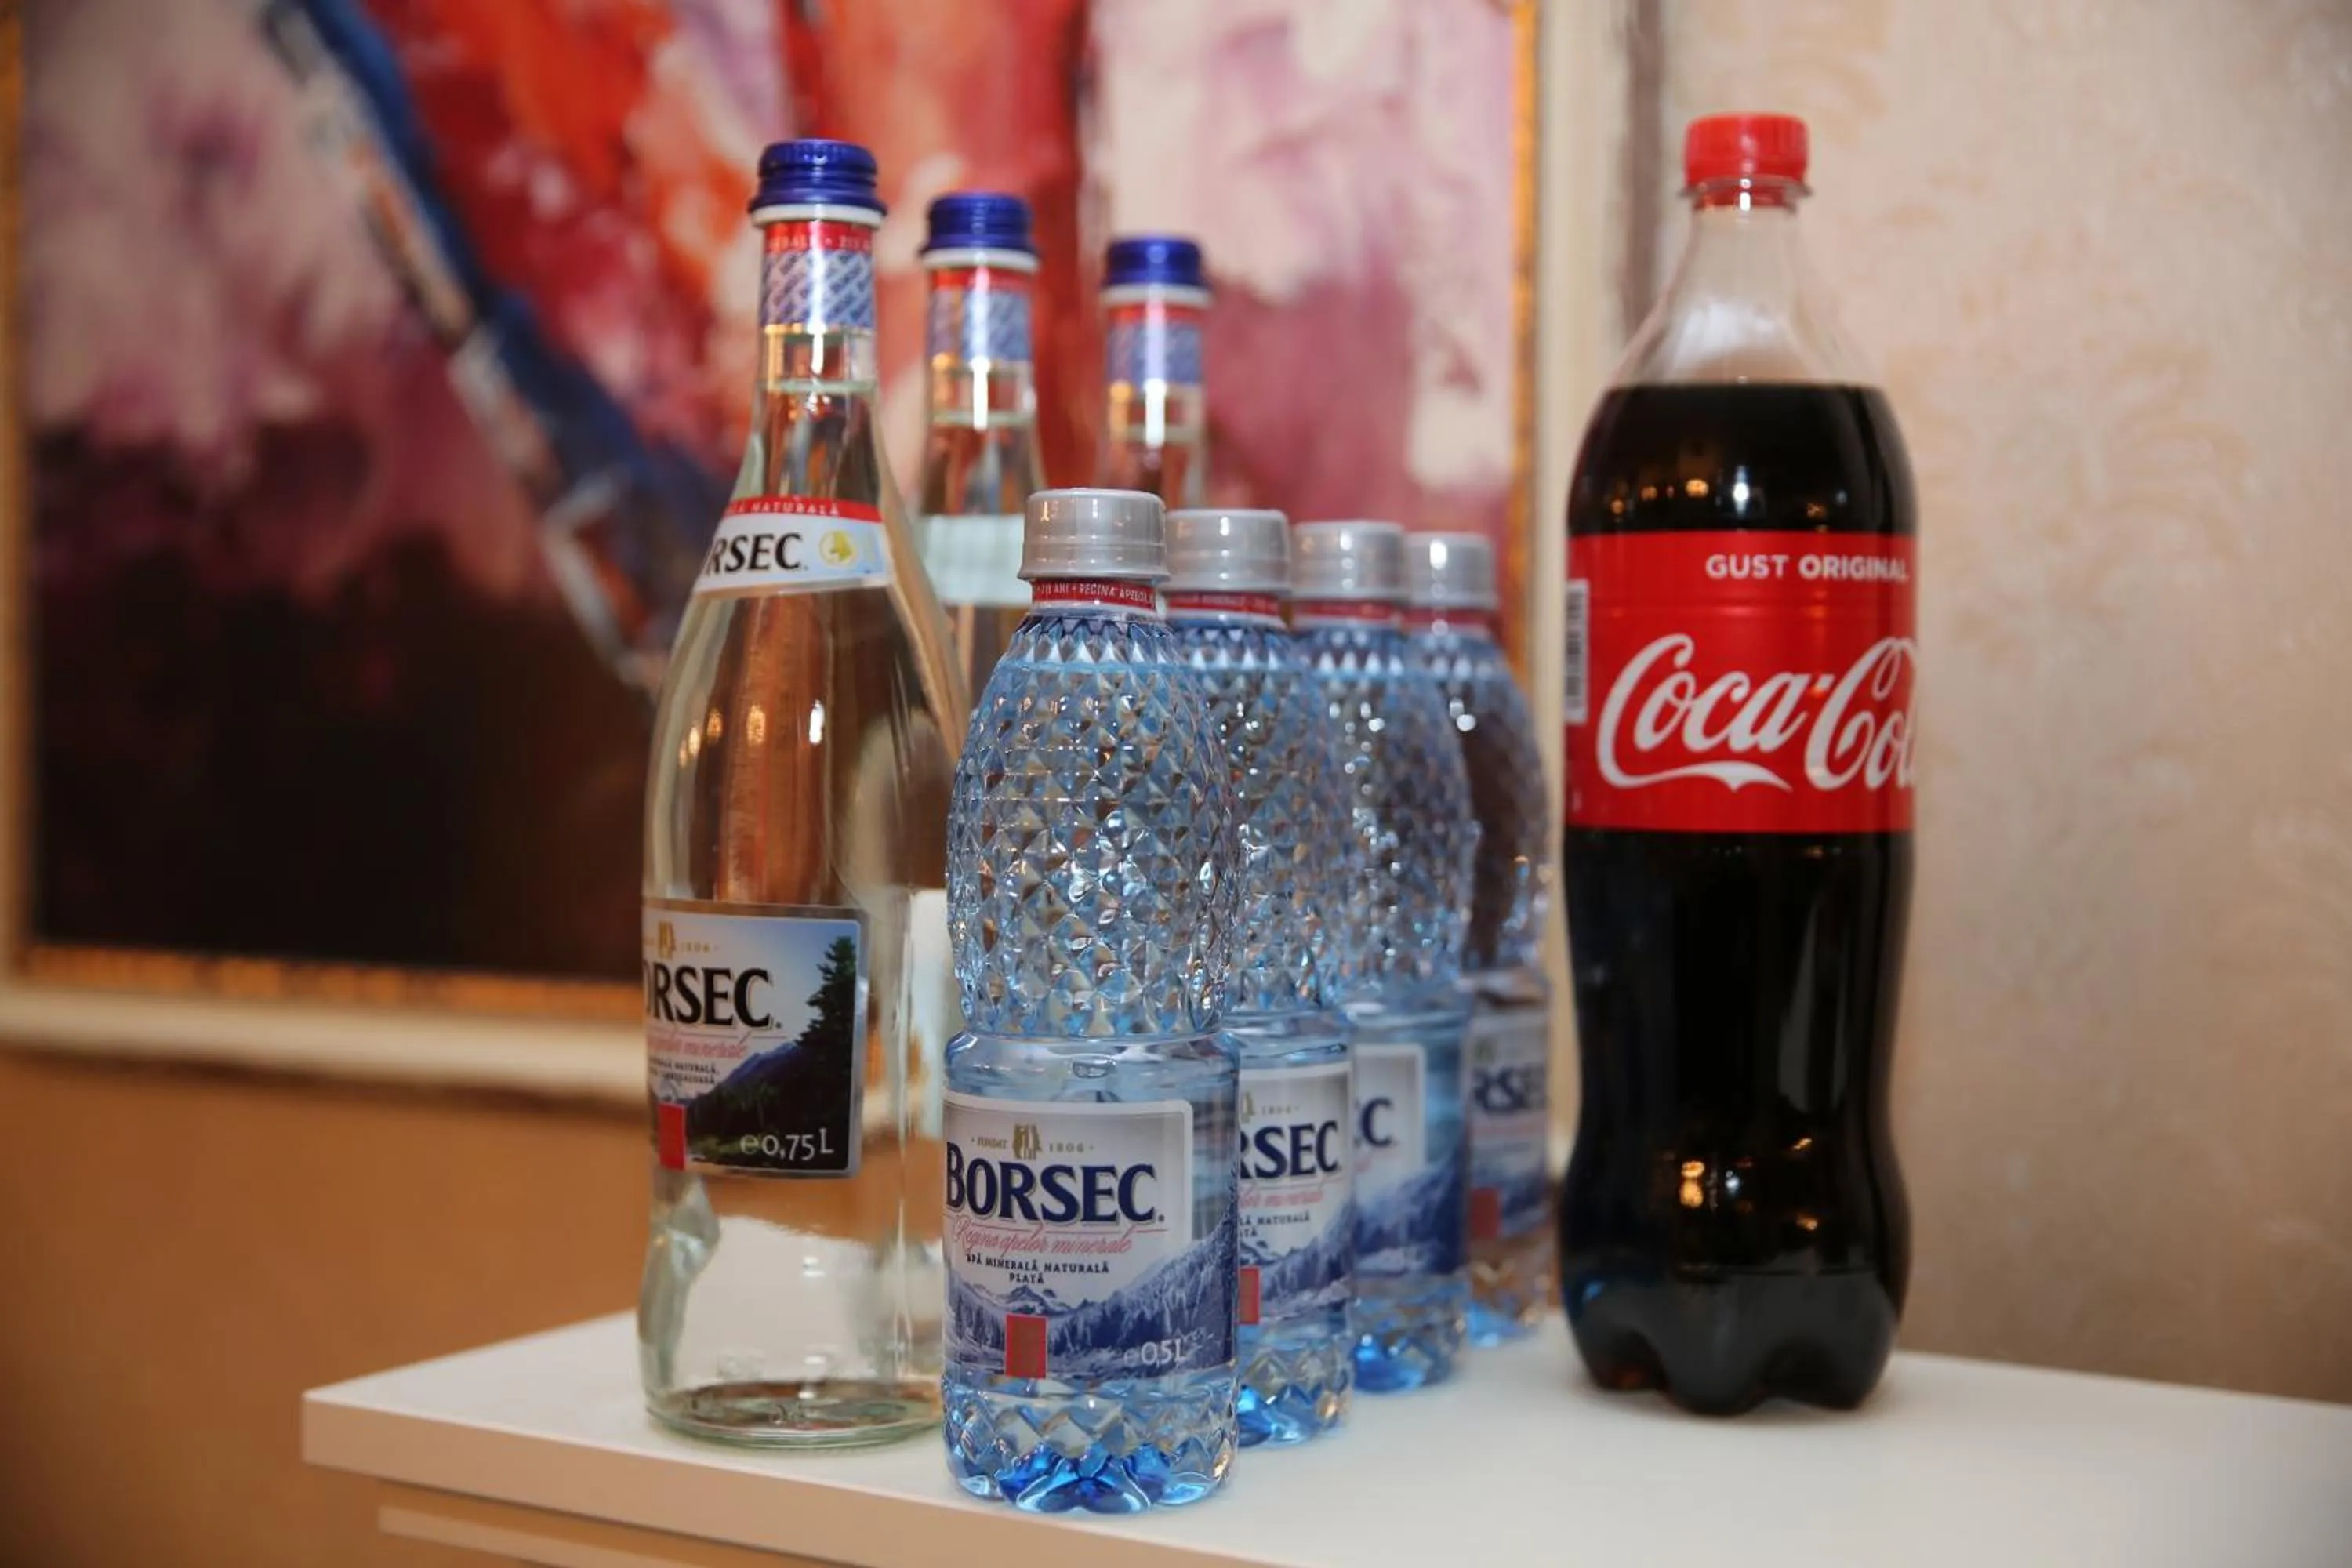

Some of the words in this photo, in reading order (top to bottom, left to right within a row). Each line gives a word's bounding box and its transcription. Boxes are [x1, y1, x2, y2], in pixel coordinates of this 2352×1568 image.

[1706, 554, 1789, 579] GUST
[1798, 554, 1909, 581] ORIGINAL
[1596, 633, 1916, 792] Coca-Col
[1049, 1142, 1084, 1153] 1806
[946, 1141, 1156, 1223] BORSEC
